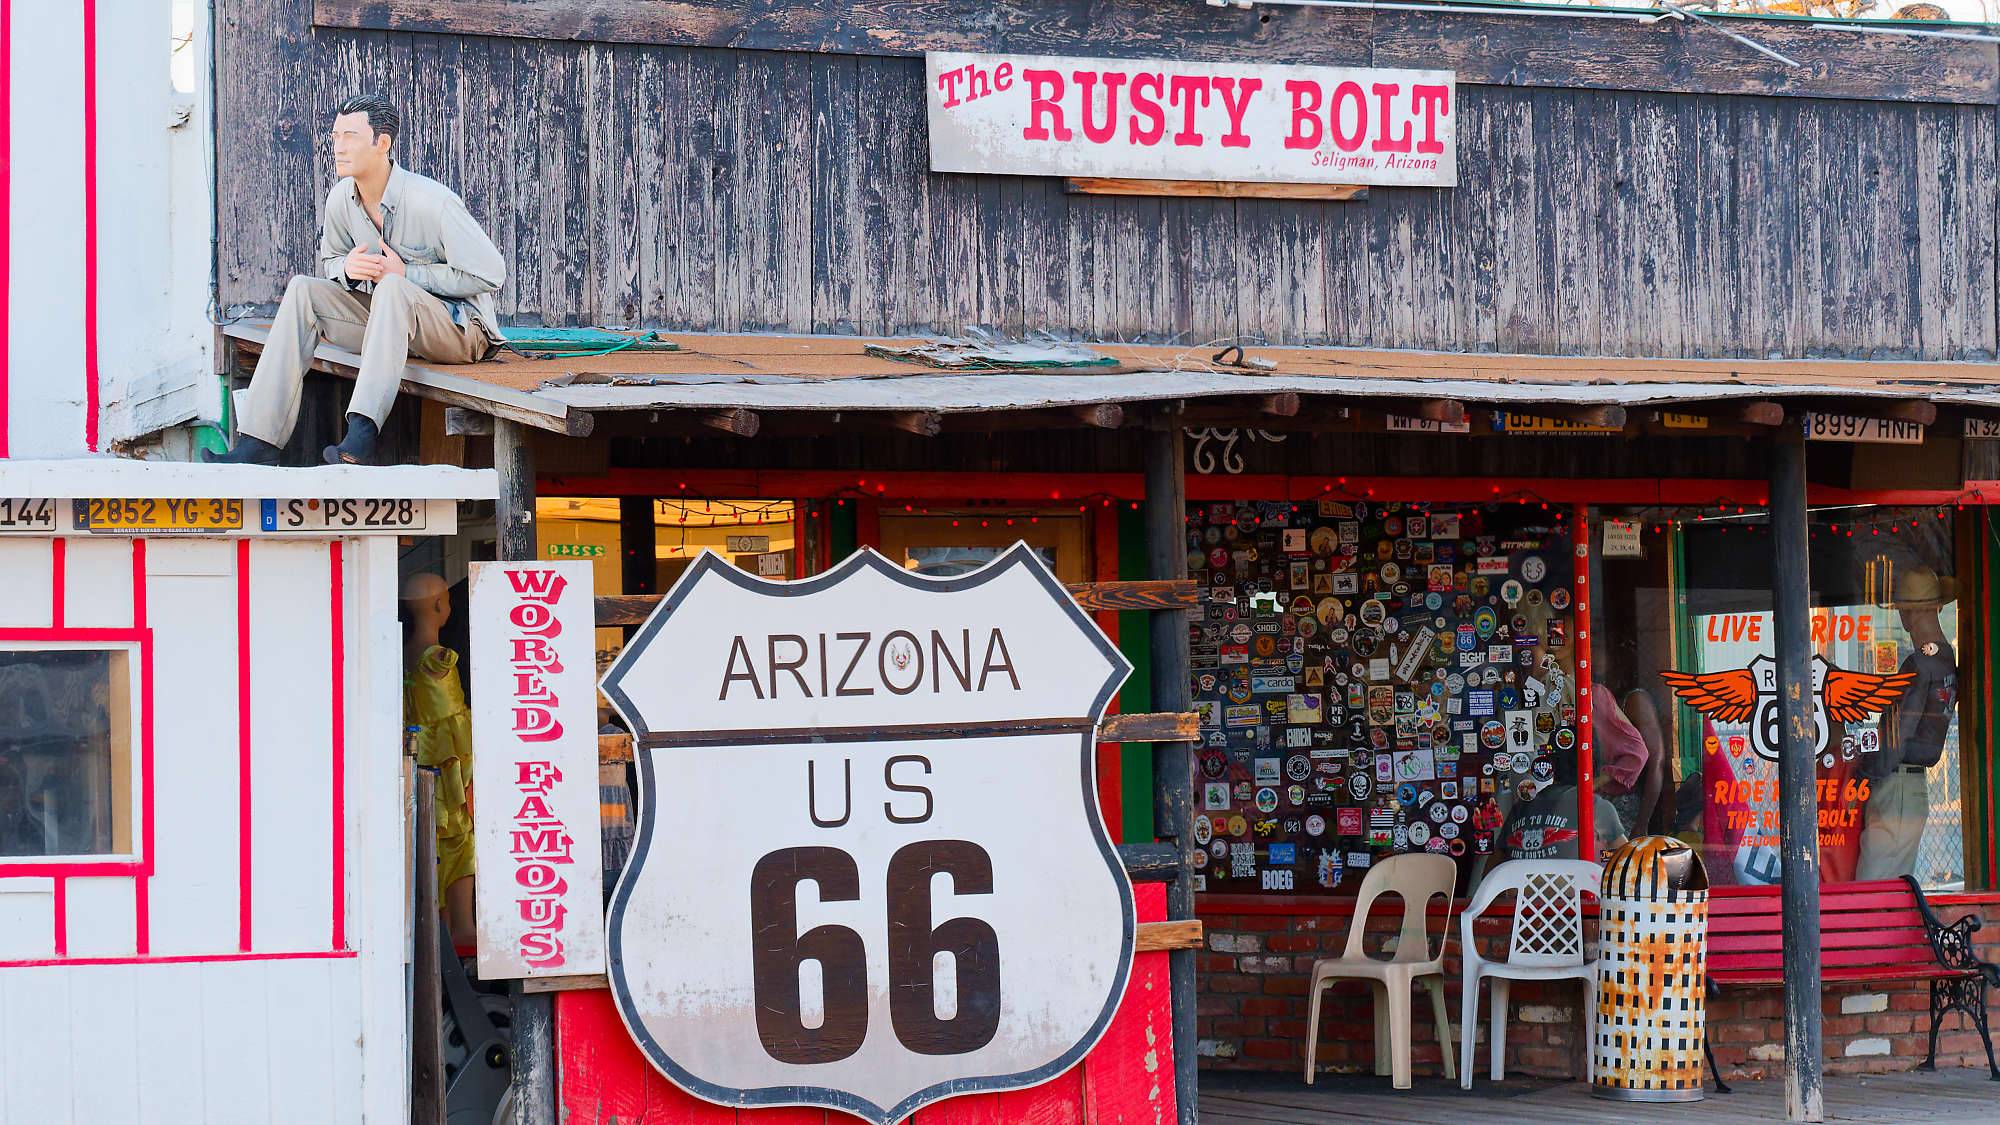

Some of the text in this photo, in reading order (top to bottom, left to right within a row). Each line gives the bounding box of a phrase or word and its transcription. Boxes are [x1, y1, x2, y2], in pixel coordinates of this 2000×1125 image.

[938, 62, 1013, 109] The
[1023, 69, 1449, 154] RUSTY BOLT
[1311, 150, 1438, 171] Seligman, Arizona
[1814, 413, 1870, 437] 8997
[1, 498, 50, 525] 144
[90, 499, 242, 524] 2852 YG 35
[287, 499, 413, 526] S PS 228
[1256, 624, 1278, 633] SHOEI
[1460, 636, 1472, 645] 66
[1707, 615, 1763, 643] LIVE
[1811, 615, 1872, 643] RIDE
[503, 569, 568, 743] WORLD
[718, 627, 1022, 701] ARIZONA
[1459, 651, 1487, 664] EIGHT
[1267, 677, 1294, 688] cardo
[1714, 780, 1764, 805] RIDE
[1843, 777, 1871, 802] 66
[1726, 810, 1758, 830] THE
[1817, 808, 1859, 828] BOLT
[1525, 840, 1540, 848] 66
[510, 761, 575, 969] FAMOUS
[1261, 869, 1294, 890] BOEG
[750, 839, 1002, 1066] 66
